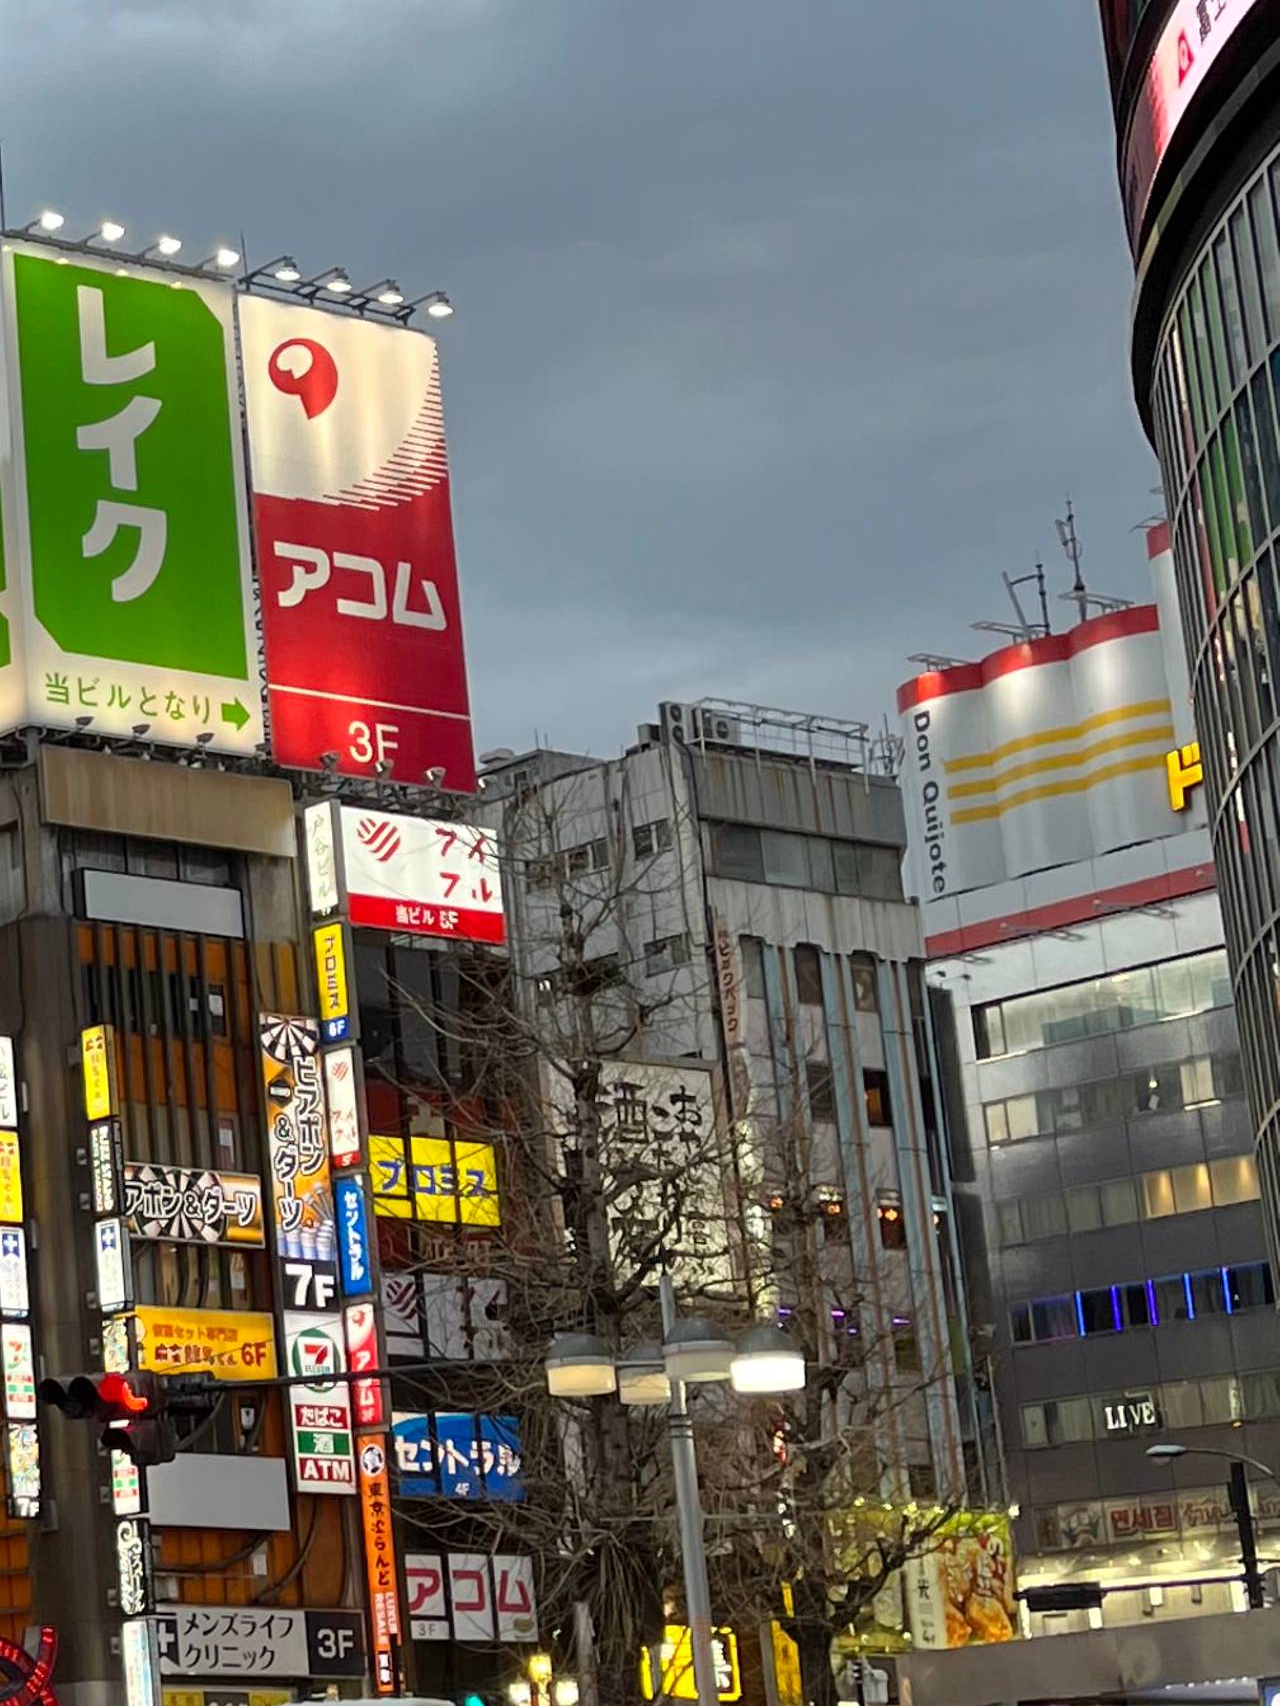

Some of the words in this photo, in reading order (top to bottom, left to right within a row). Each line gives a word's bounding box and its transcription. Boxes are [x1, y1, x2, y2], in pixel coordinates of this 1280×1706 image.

[76, 284, 168, 603] レイク
[272, 540, 448, 631] アコム
[44, 670, 212, 725] 当ビルとなり
[348, 719, 400, 765] 3F
[912, 709, 938, 773] Don
[921, 780, 947, 895] Quijote
[291, 1054, 326, 1176] ビアポン
[377, 1156, 489, 1197] プロミス
[343, 1191, 366, 1281] セントラル
[284, 1263, 335, 1308] 7F
[240, 1341, 268, 1368] 6F
[298, 1406, 343, 1428] たばこ
[1104, 1401, 1156, 1430] LIVE
[302, 1458, 351, 1481] ATM
[403, 1565, 533, 1615] アコム
[182, 1612, 295, 1640] メンズライフ
[317, 1628, 355, 1660] 3F
[417, 1623, 437, 1638] 3F
[182, 1645, 277, 1671] クリニック
